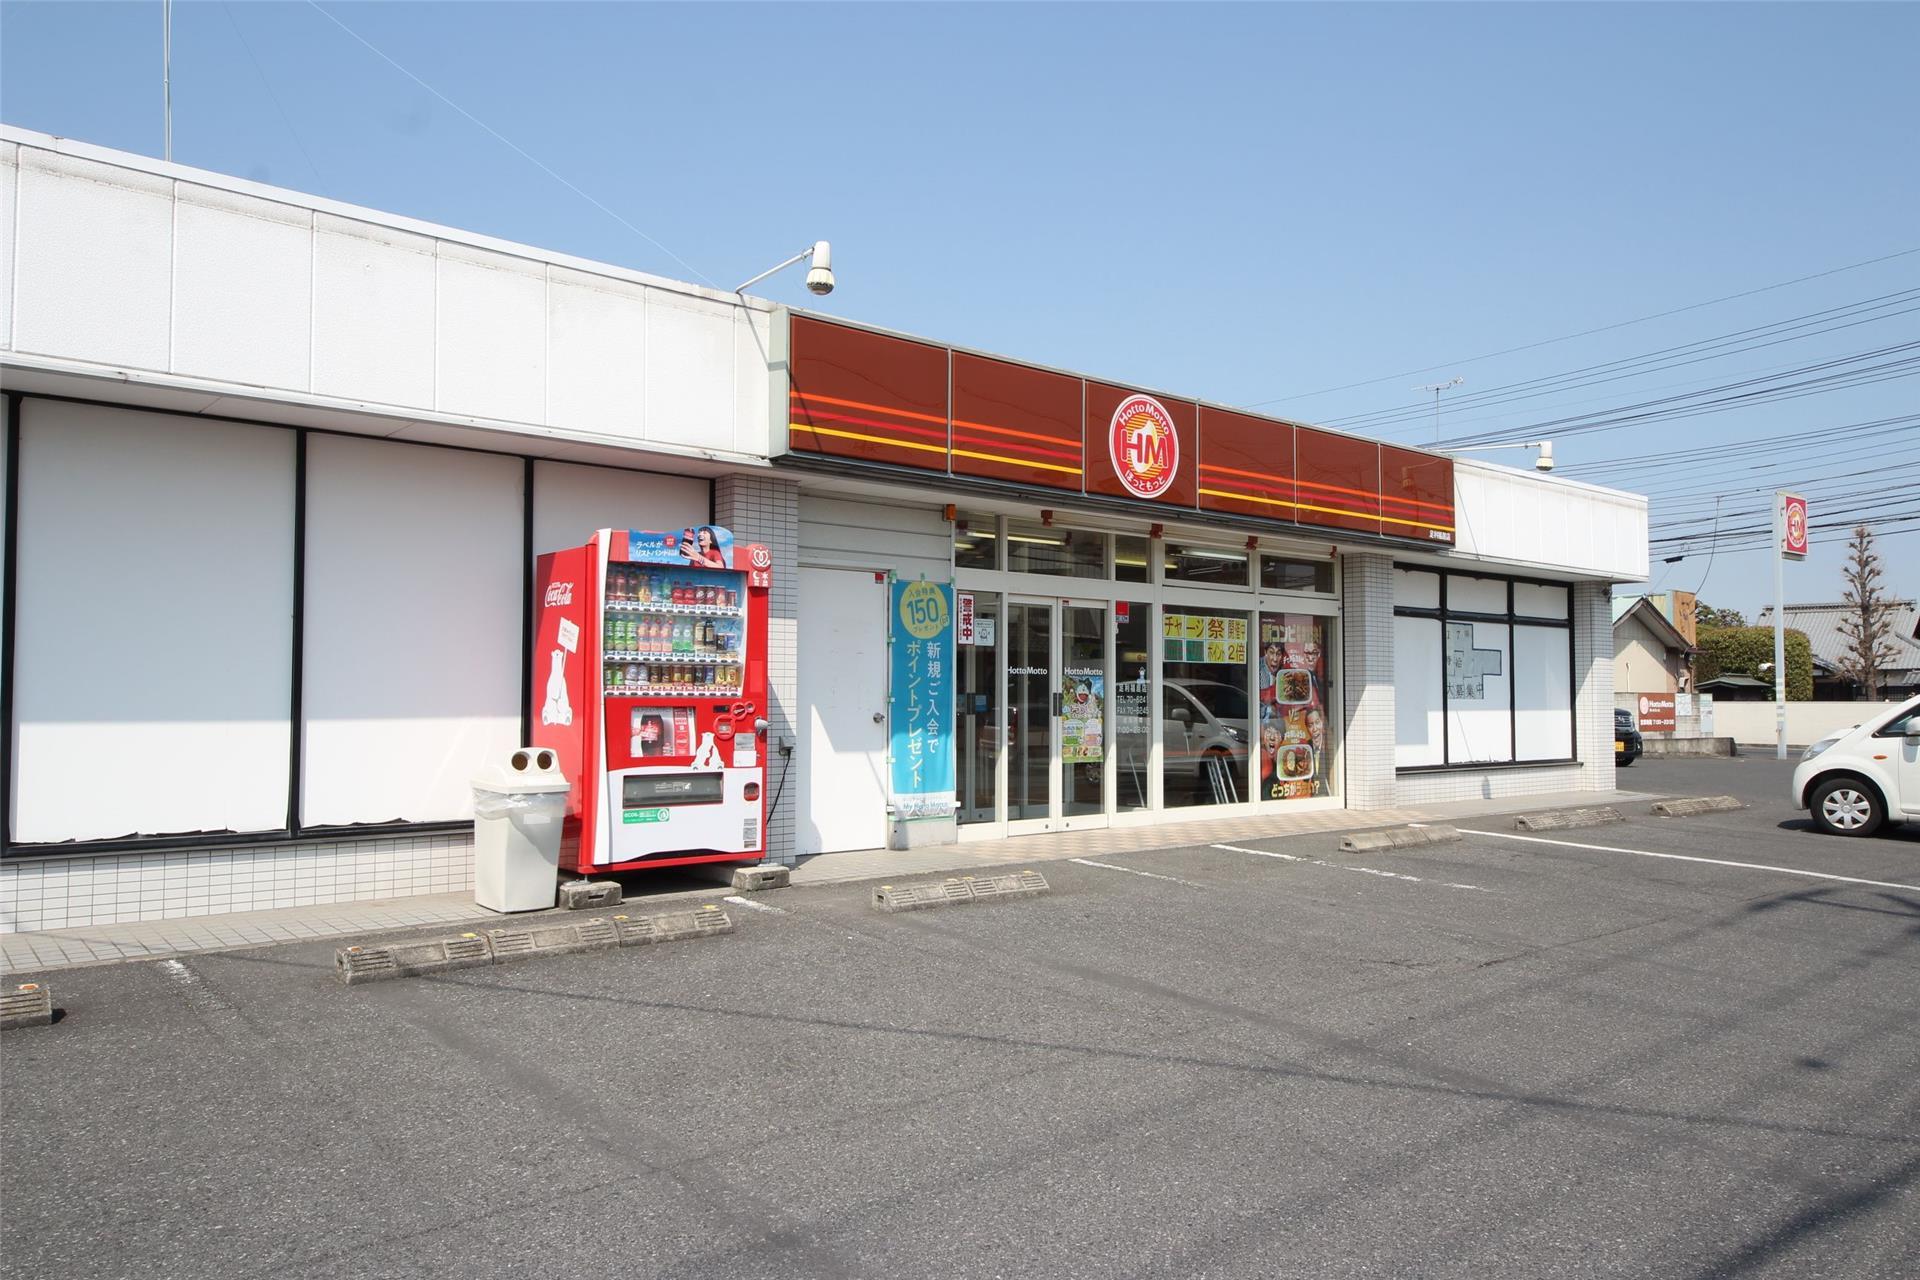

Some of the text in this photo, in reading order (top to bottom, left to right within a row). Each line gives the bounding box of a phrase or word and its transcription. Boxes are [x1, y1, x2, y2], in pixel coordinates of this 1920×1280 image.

[1125, 469, 1166, 491] ほっともっと
[636, 540, 664, 549] ラベルが
[544, 582, 574, 608] Coca-Cola
[907, 597, 939, 625] 150
[962, 598, 973, 641] 警戒中
[926, 641, 942, 754] 新規ご入会で
[907, 639, 924, 789] ポイントプレゼント
